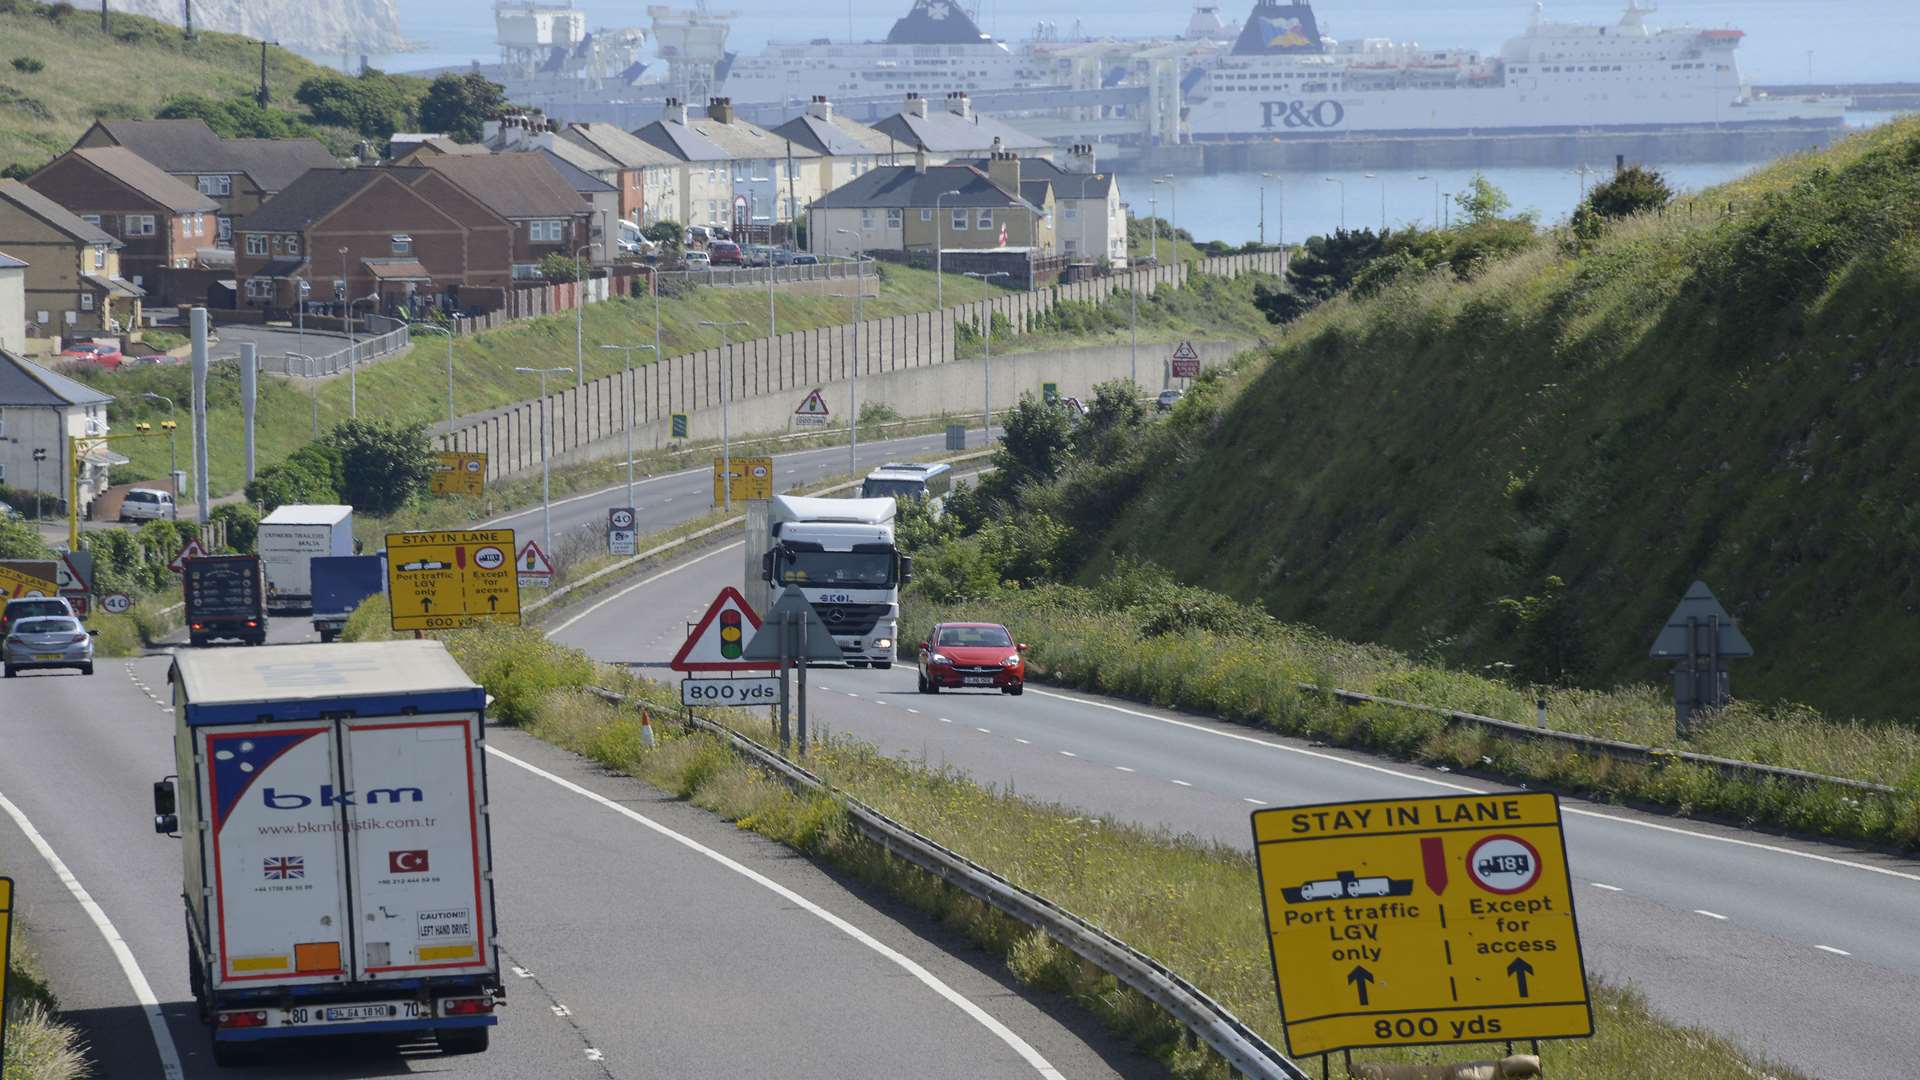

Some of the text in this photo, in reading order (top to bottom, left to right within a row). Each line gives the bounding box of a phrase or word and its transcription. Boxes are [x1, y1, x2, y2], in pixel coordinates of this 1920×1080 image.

[1260, 100, 1344, 128] P&O
[614, 515, 631, 523] 40
[402, 532, 498, 544] STAY IN LANE
[421, 571, 454, 579] traffic
[415, 588, 436, 597] only
[107, 599, 127, 608] 40
[426, 618, 454, 627] 600
[690, 684, 774, 701] 800 yds
[263, 785, 424, 810] bkm
[1291, 800, 1522, 833] STAY IN LANE
[258, 816, 438, 836] www.bkmloistik.com.tr
[1469, 896, 1553, 914] Except
[420, 911, 466, 920] CAUTION!!!
[1285, 902, 1420, 926] Port traffic
[421, 923, 469, 936] LEFT HAND DRIVE
[1330, 923, 1378, 941] LGV
[1496, 917, 1530, 933] for
[1332, 944, 1381, 962] only
[1476, 938, 1557, 954] access
[292, 1009, 308, 1024] 80
[403, 1002, 419, 1017] 70
[1374, 1014, 1502, 1039] 800 yds
